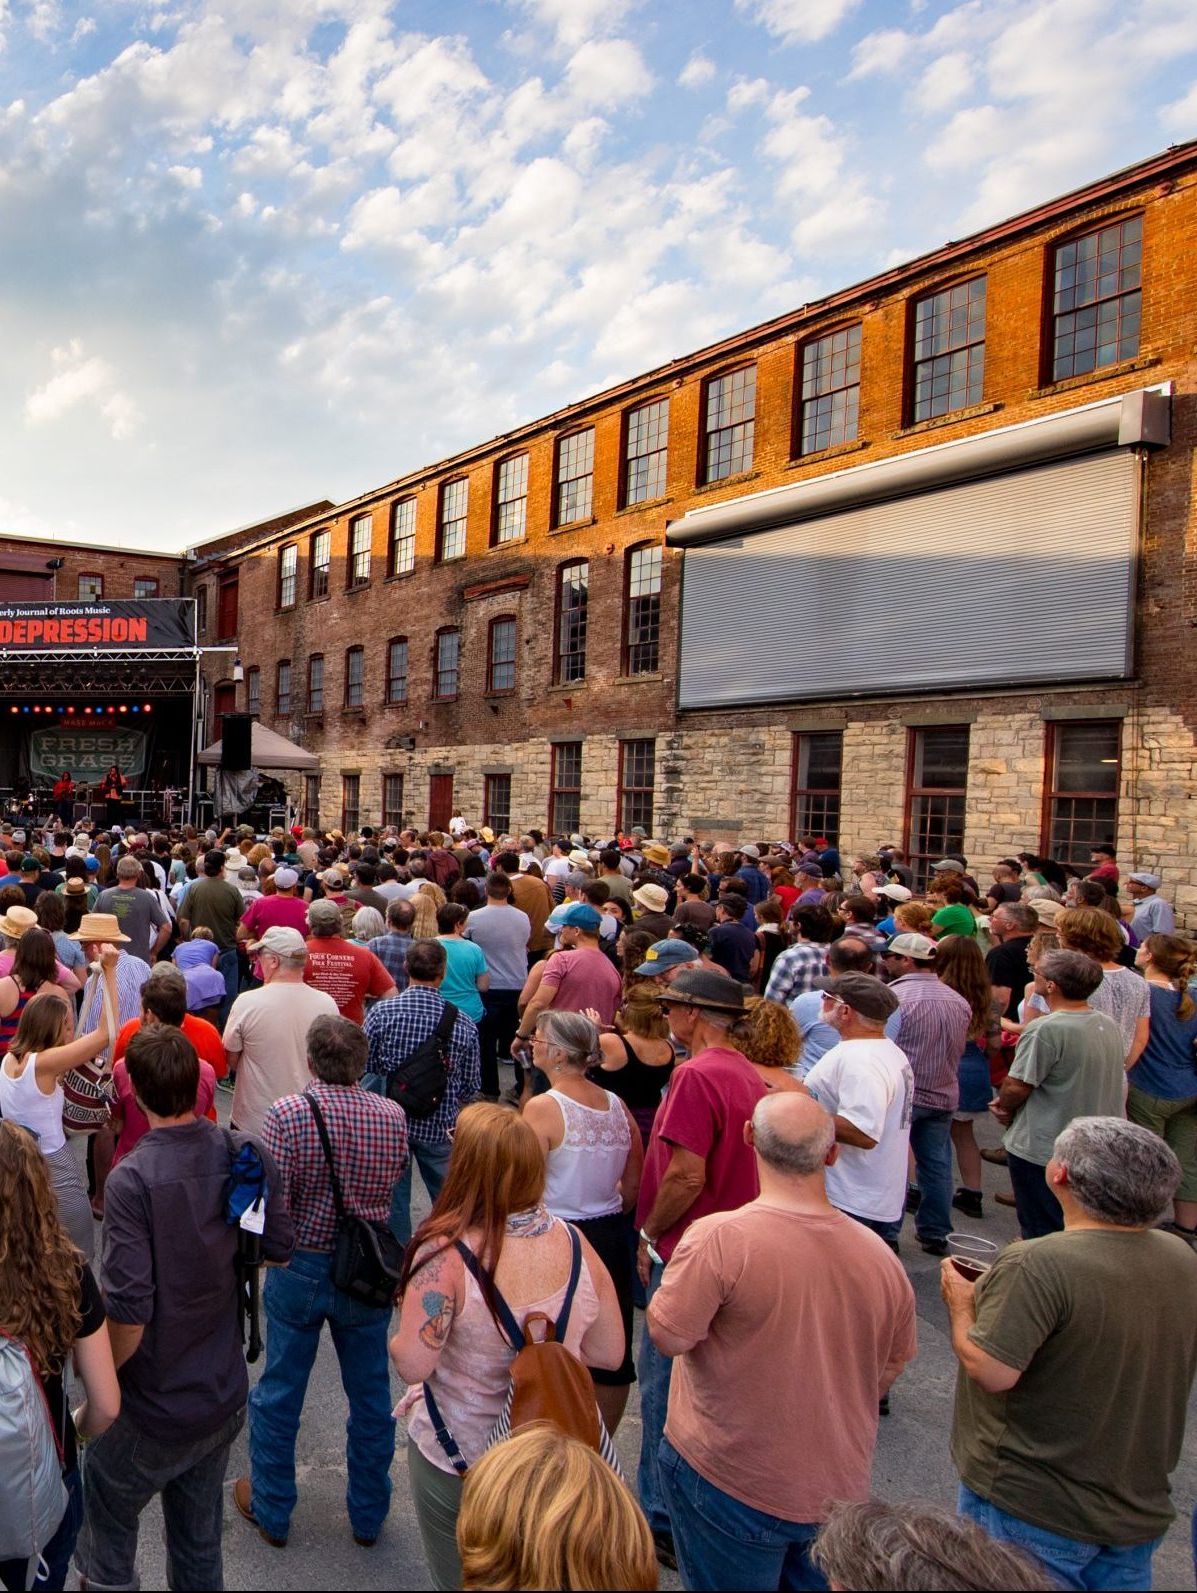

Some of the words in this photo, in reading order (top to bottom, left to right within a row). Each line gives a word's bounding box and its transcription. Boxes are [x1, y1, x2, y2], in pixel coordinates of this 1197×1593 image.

[16, 607, 48, 617] Journal
[49, 607, 59, 616] of
[59, 607, 84, 615] Roots
[84, 606, 111, 614] Music
[40, 737, 135, 752] FRESH
[40, 754, 135, 768] GRASS
